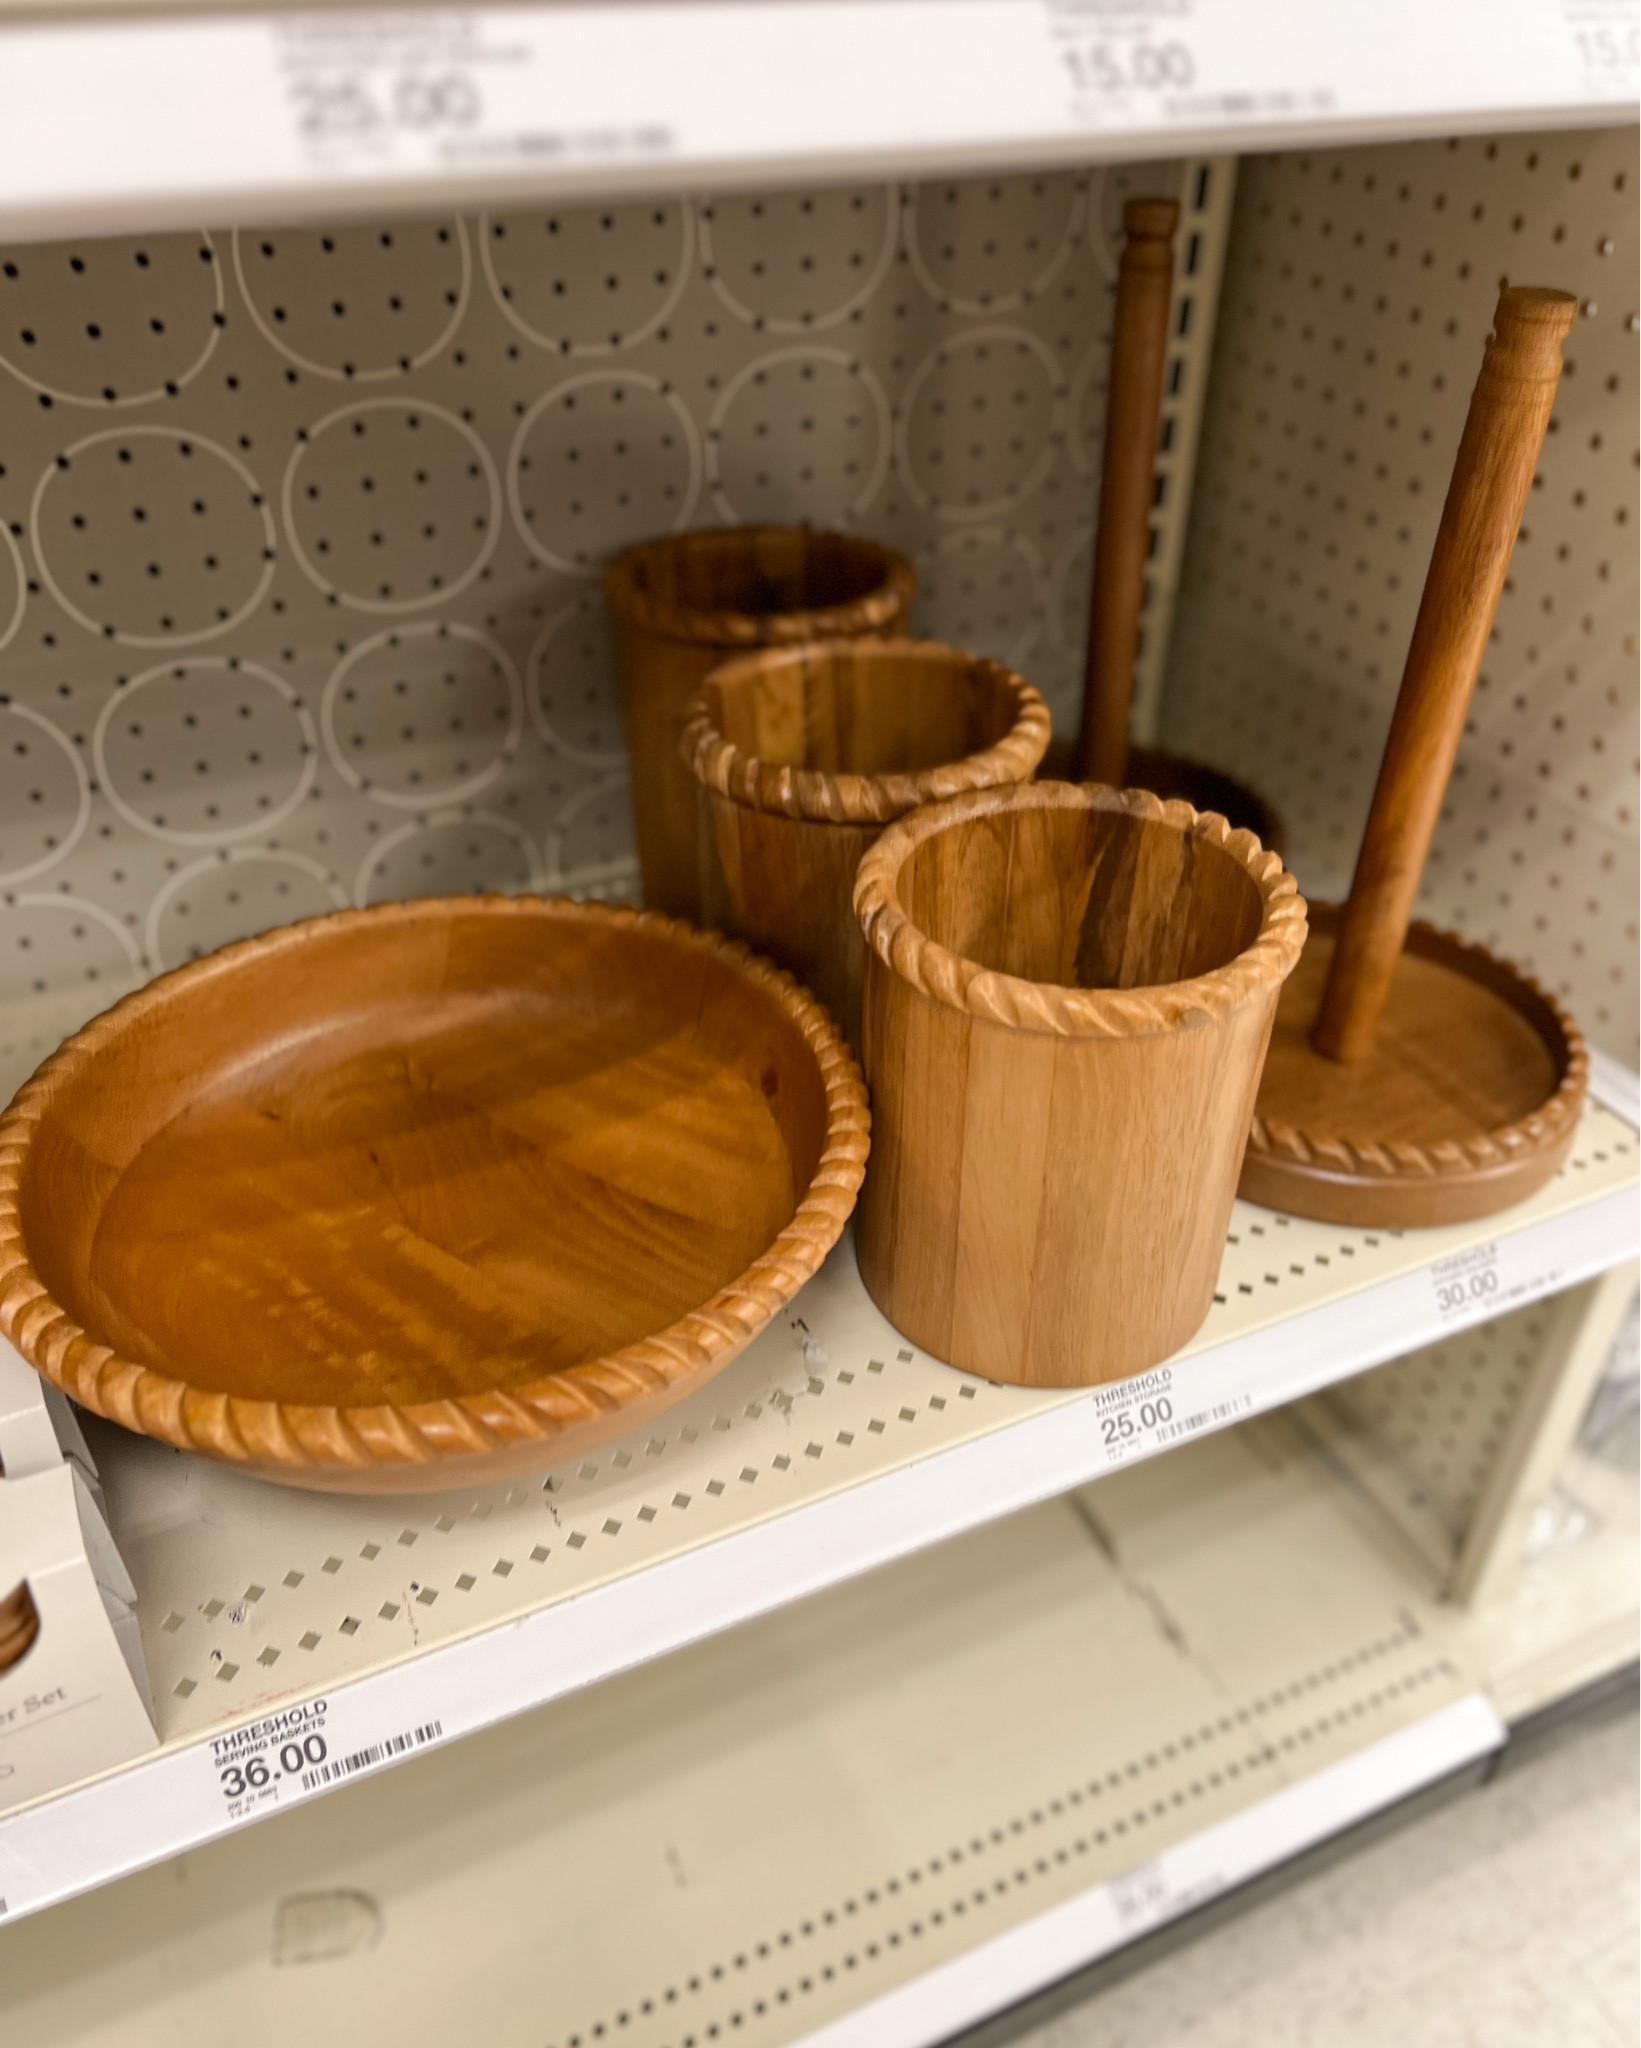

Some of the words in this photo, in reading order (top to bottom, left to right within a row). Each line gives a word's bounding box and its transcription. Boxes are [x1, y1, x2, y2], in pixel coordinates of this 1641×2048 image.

[1063, 41, 1196, 91] 15.00
[1437, 1270, 1499, 1311] 30.00
[1093, 1369, 1172, 1408] THRESHOLD
[1096, 1396, 1132, 1418] KITCHEN
[1133, 1384, 1172, 1404] STORAGE
[1101, 1397, 1173, 1446] 25.00
[23, 1686, 68, 1714] Set
[209, 1699, 328, 1755] THRESHOLD
[214, 1739, 268, 1768] SERVING
[270, 1717, 326, 1747] BASKETS
[220, 1733, 328, 1798] 36.00
